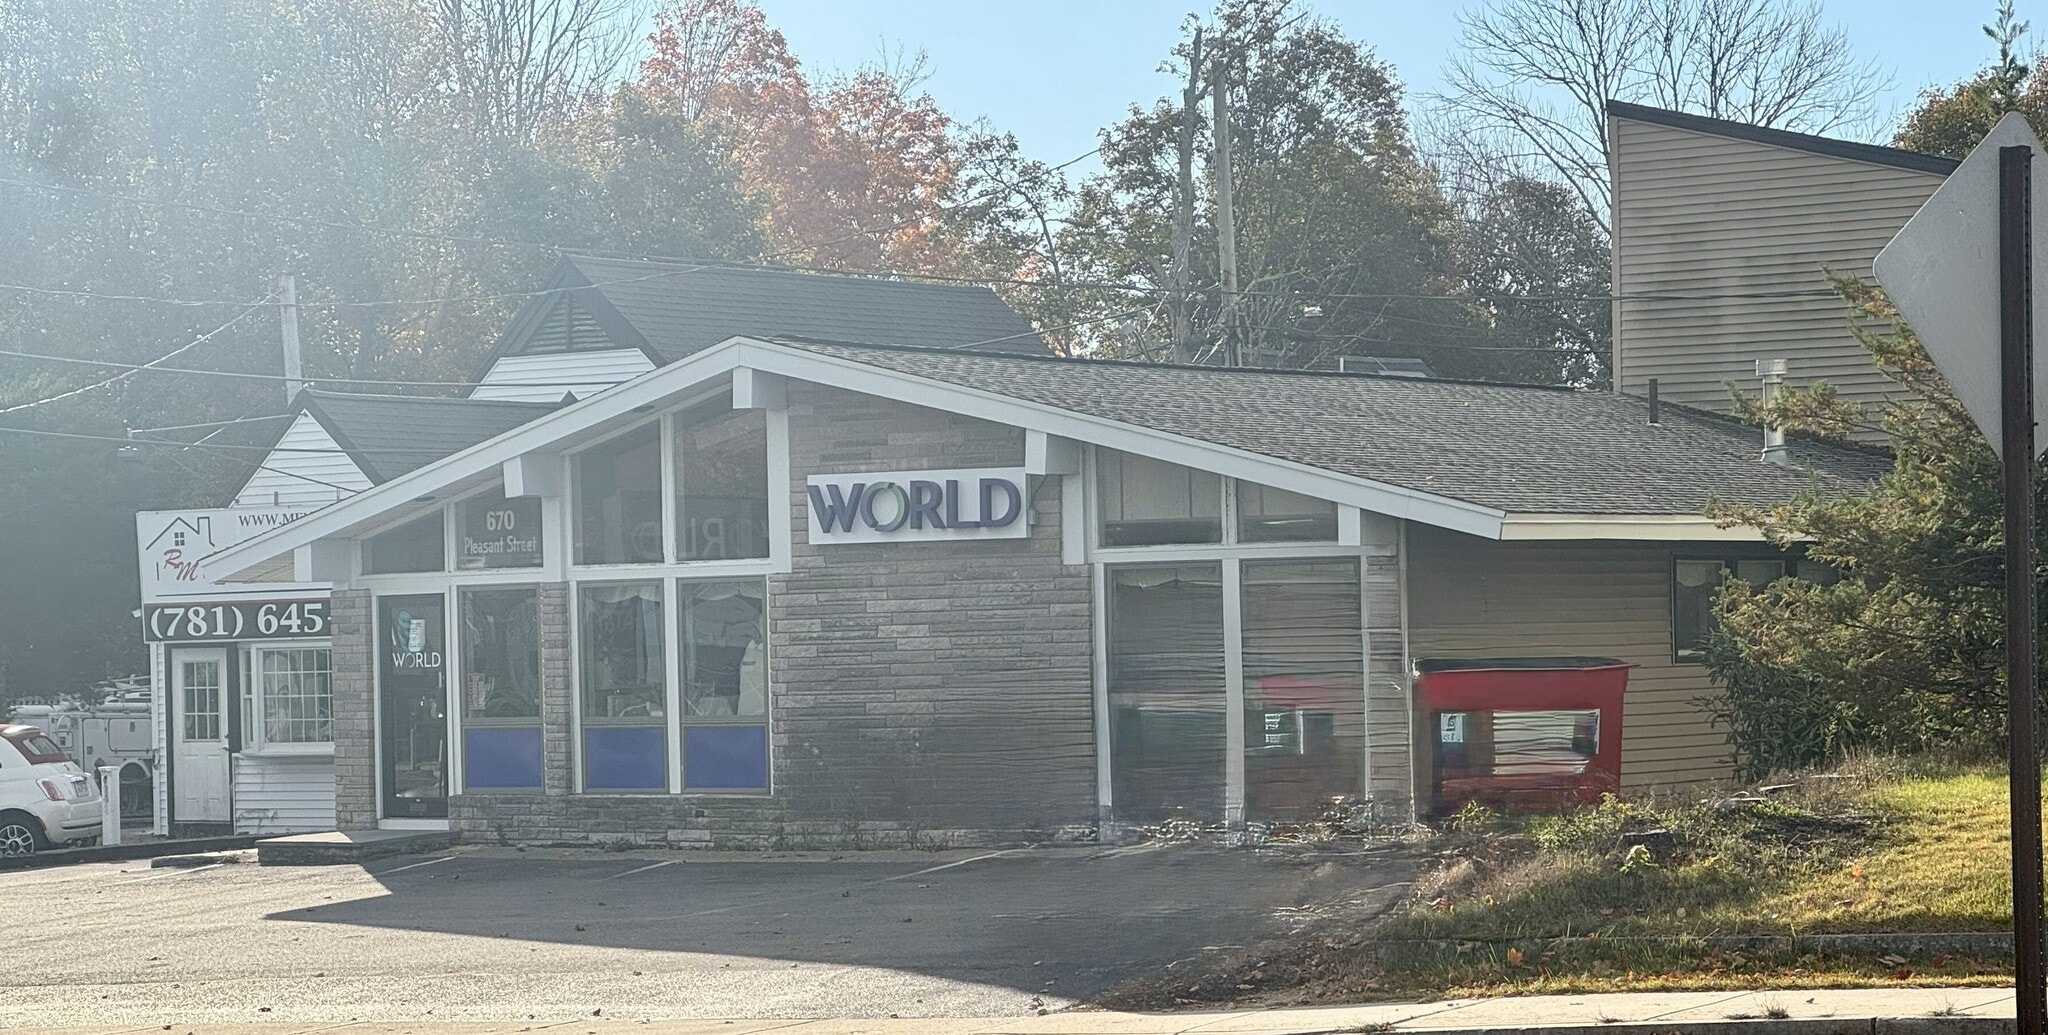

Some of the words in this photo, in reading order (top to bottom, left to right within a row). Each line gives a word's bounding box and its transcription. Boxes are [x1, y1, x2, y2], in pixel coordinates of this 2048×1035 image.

[806, 478, 1022, 534] WORLD
[486, 510, 515, 531] 670
[464, 537, 504, 554] Pleasant
[506, 535, 537, 553] Street
[150, 605, 244, 639] (781)
[392, 652, 441, 668] WORLD
